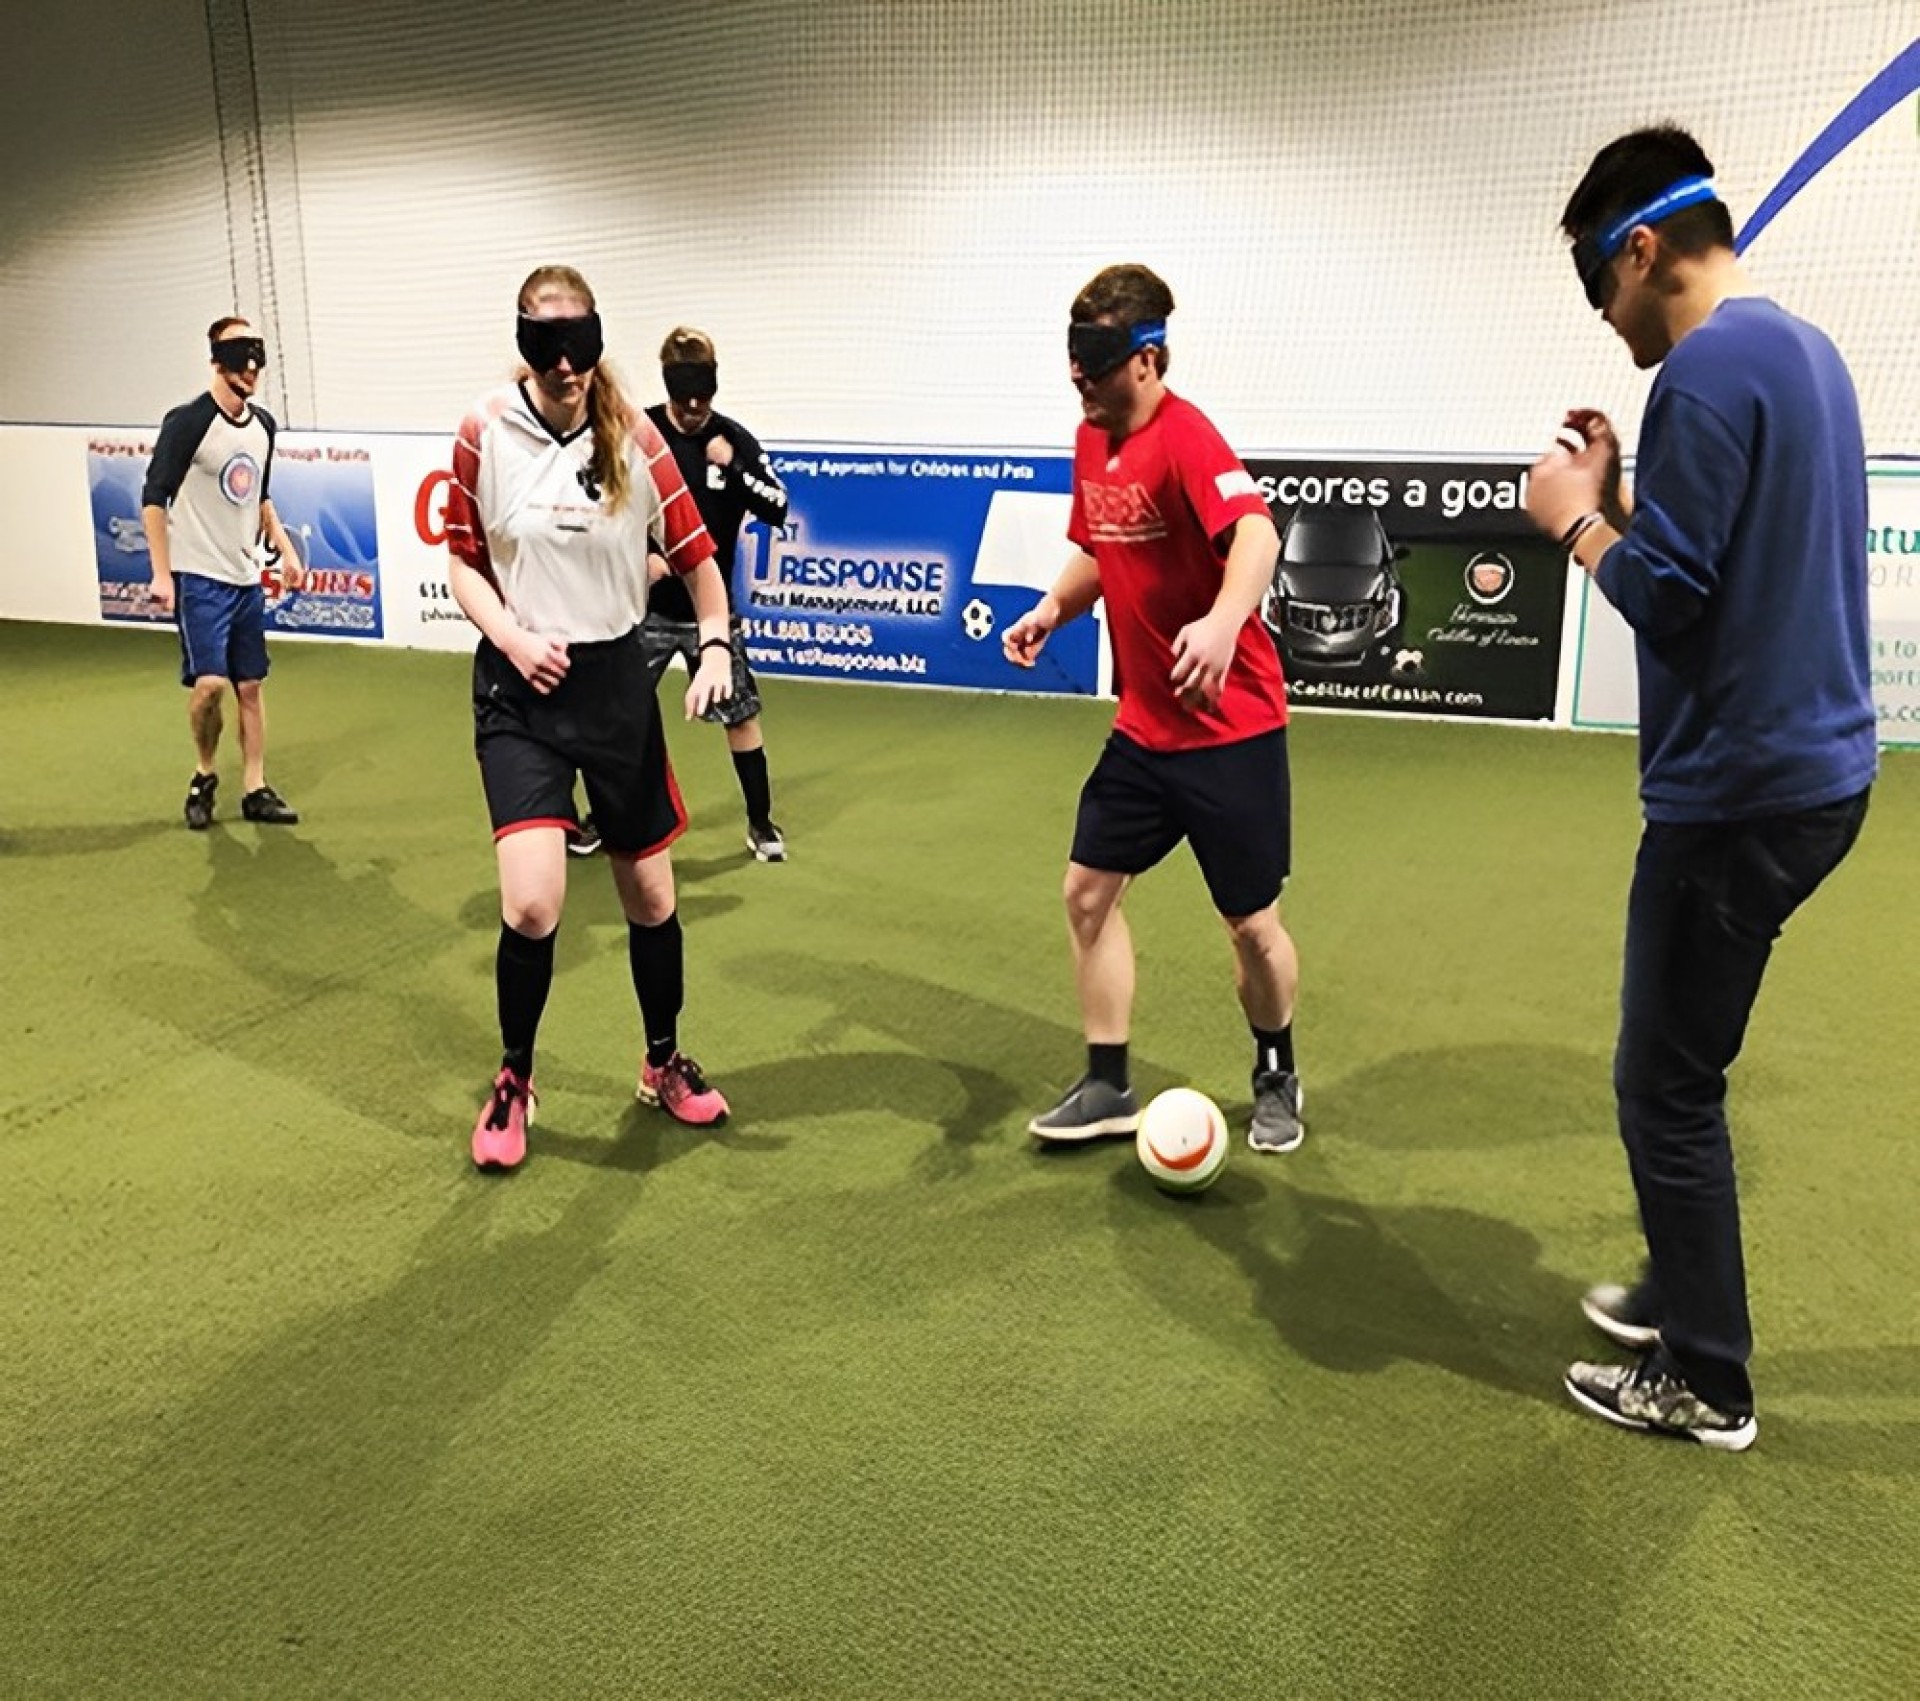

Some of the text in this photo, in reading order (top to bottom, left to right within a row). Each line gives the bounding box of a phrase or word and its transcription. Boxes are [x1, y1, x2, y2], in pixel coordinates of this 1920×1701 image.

[1257, 472, 1528, 518] scores a goal
[779, 554, 943, 592] RESPONSE
